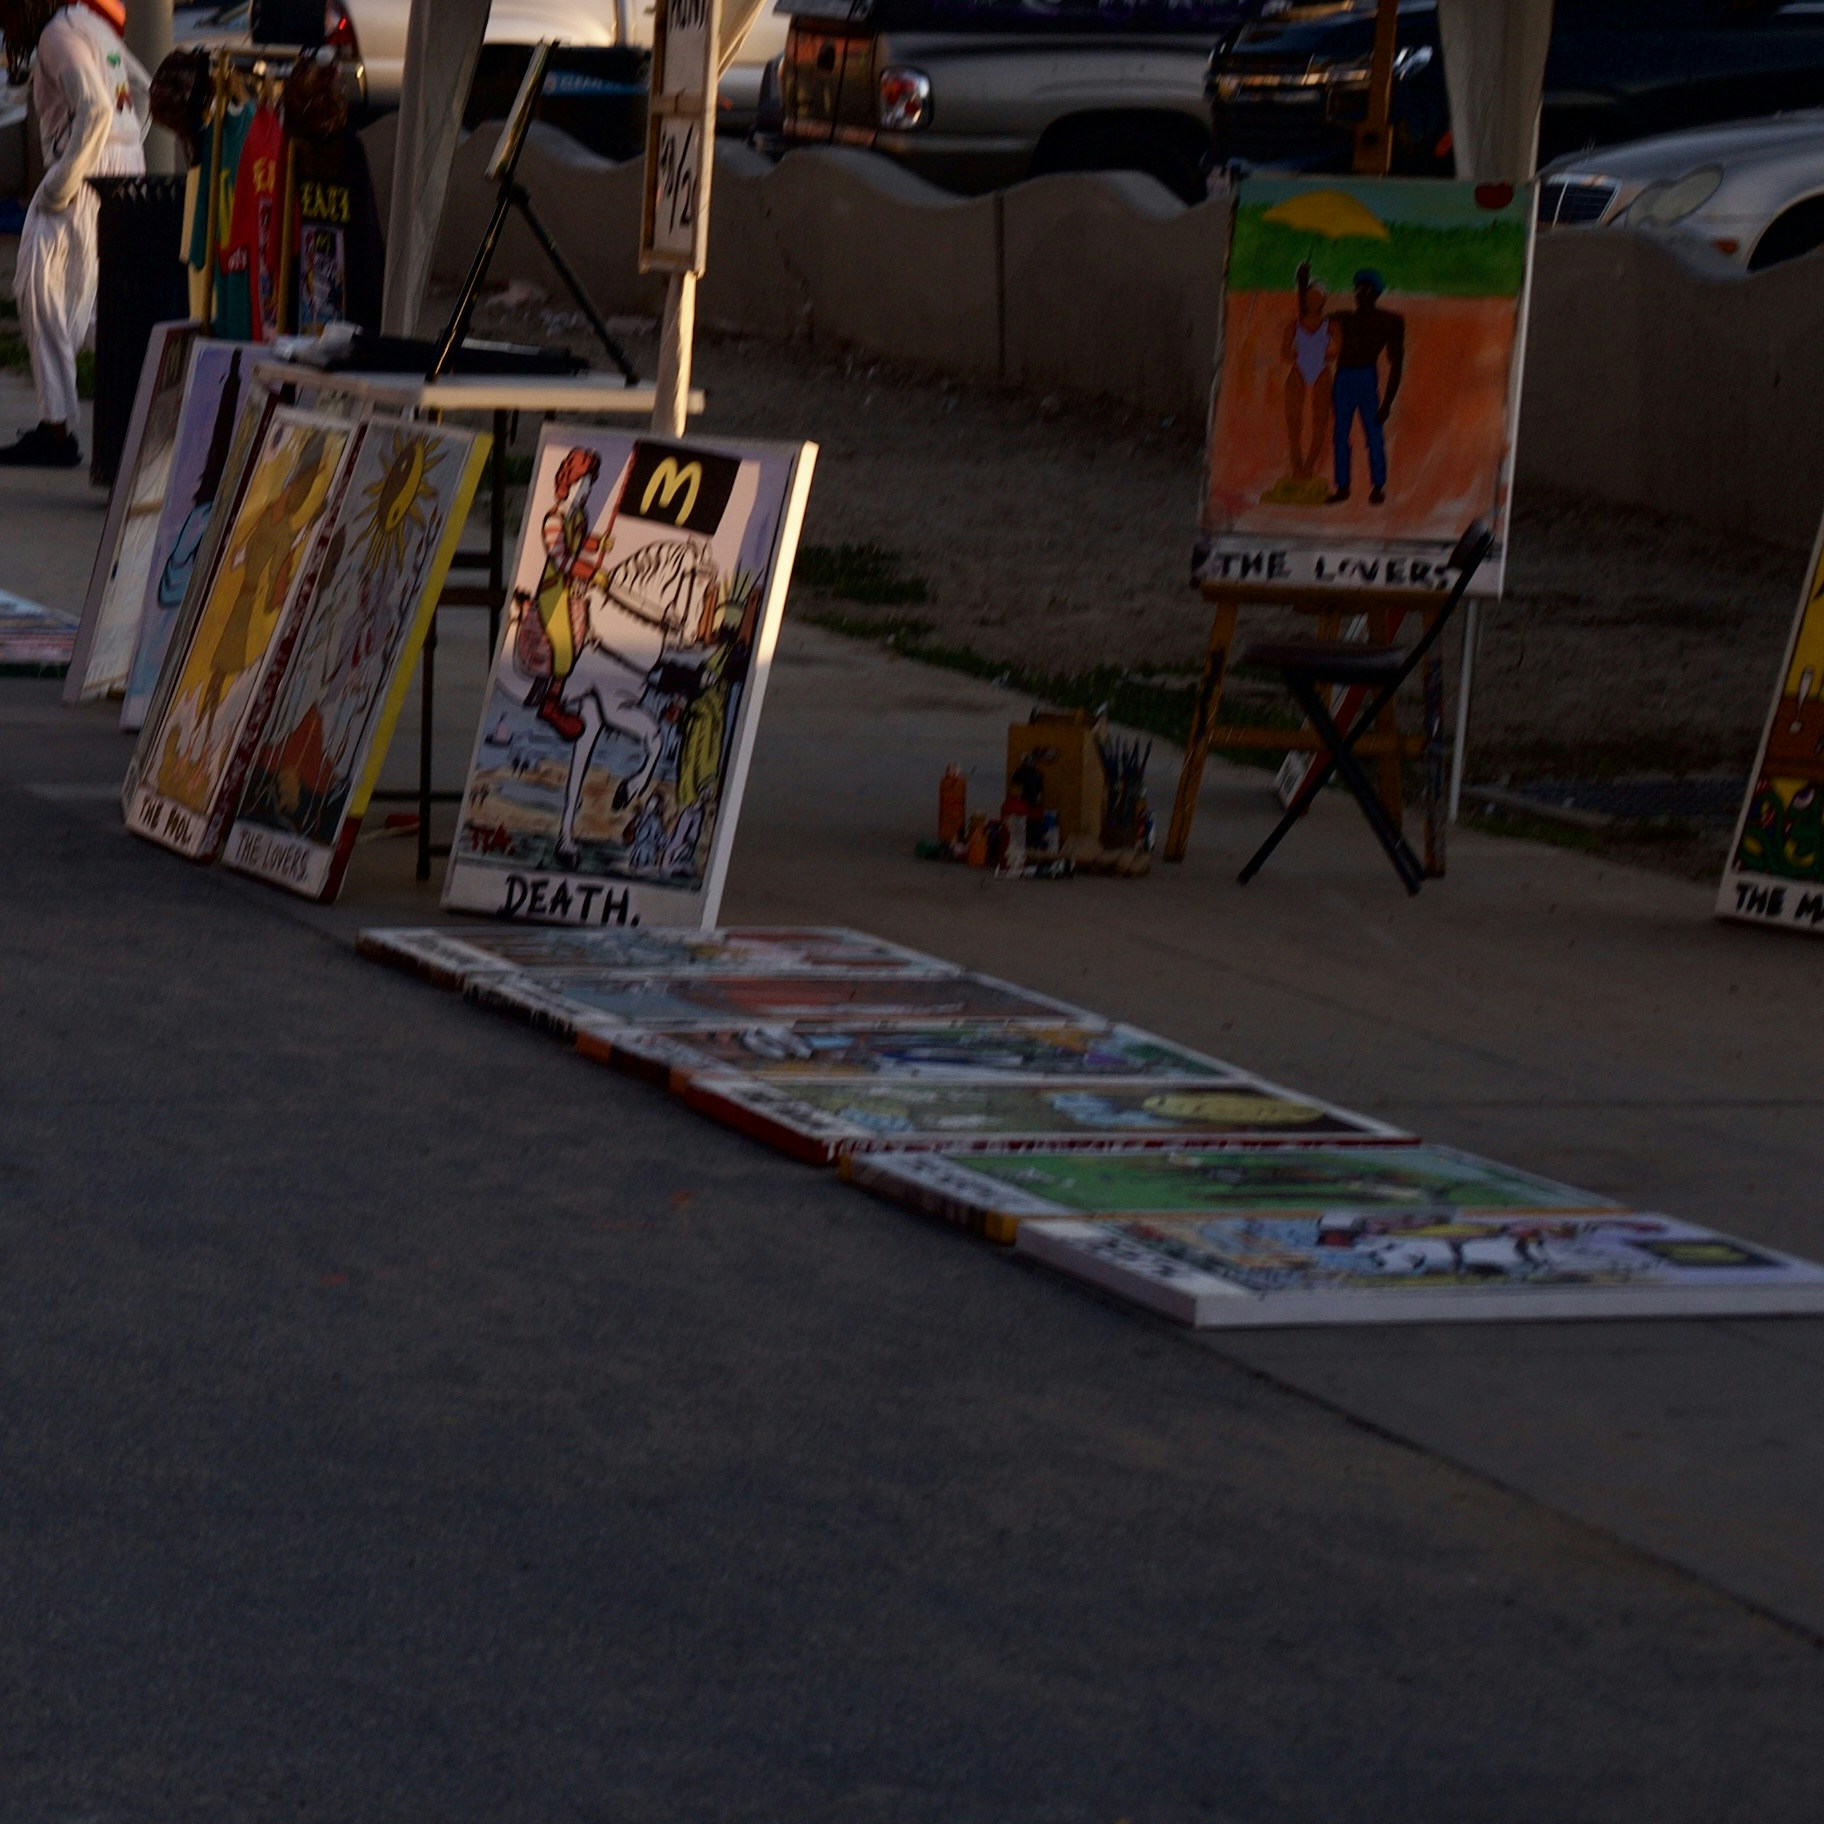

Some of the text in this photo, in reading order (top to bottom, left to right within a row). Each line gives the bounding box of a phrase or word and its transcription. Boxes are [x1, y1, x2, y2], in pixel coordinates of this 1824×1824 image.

[1218, 550, 1292, 581] THE
[139, 795, 164, 832] THE
[236, 828, 264, 865] THE
[496, 874, 642, 927] DEATH.
[1736, 881, 1824, 924] THE M
